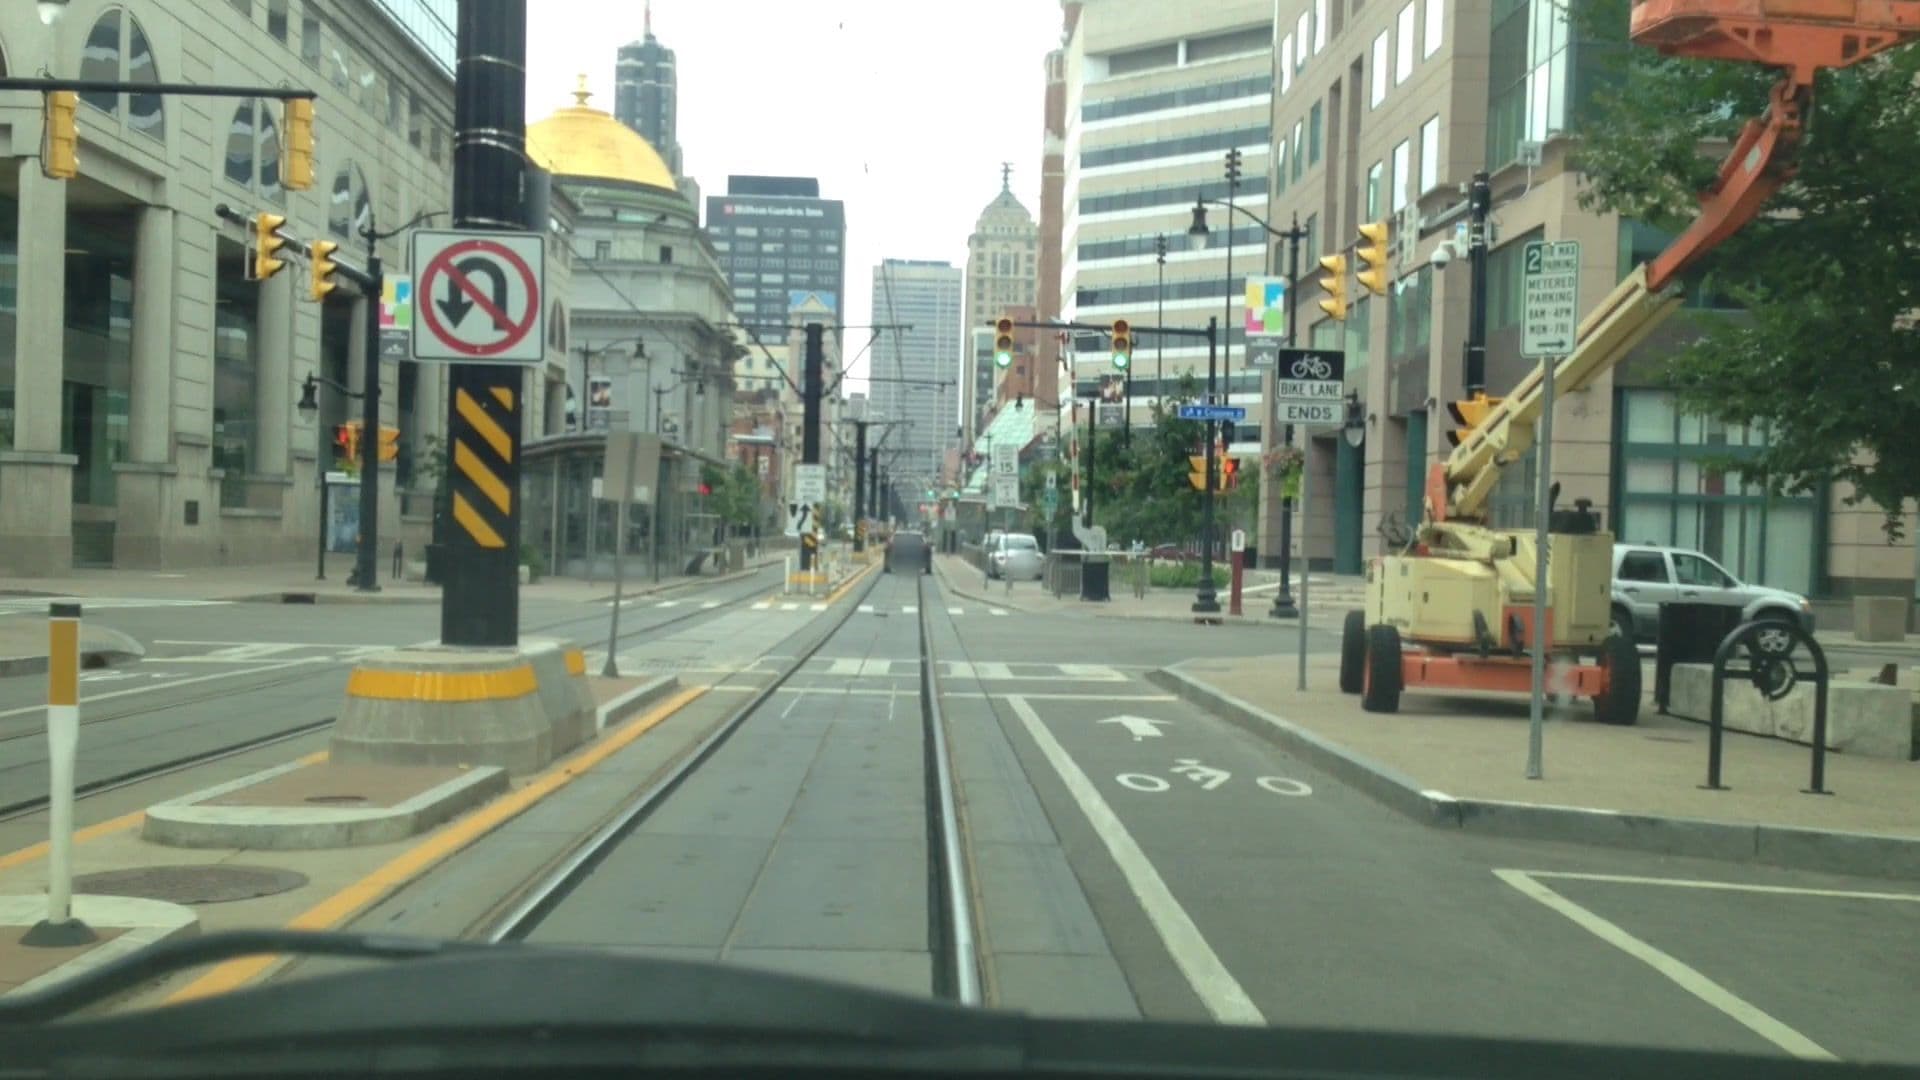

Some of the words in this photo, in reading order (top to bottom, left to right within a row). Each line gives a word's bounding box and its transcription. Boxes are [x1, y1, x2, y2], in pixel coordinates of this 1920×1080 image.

[1528, 249, 1541, 271] 2
[1528, 277, 1575, 289] METERED
[1528, 291, 1573, 304] PARKING
[1281, 382, 1305, 396] BIKE
[1310, 383, 1340, 397] LANE
[1287, 406, 1332, 420] ENDS
[1000, 461, 1014, 473] 15
